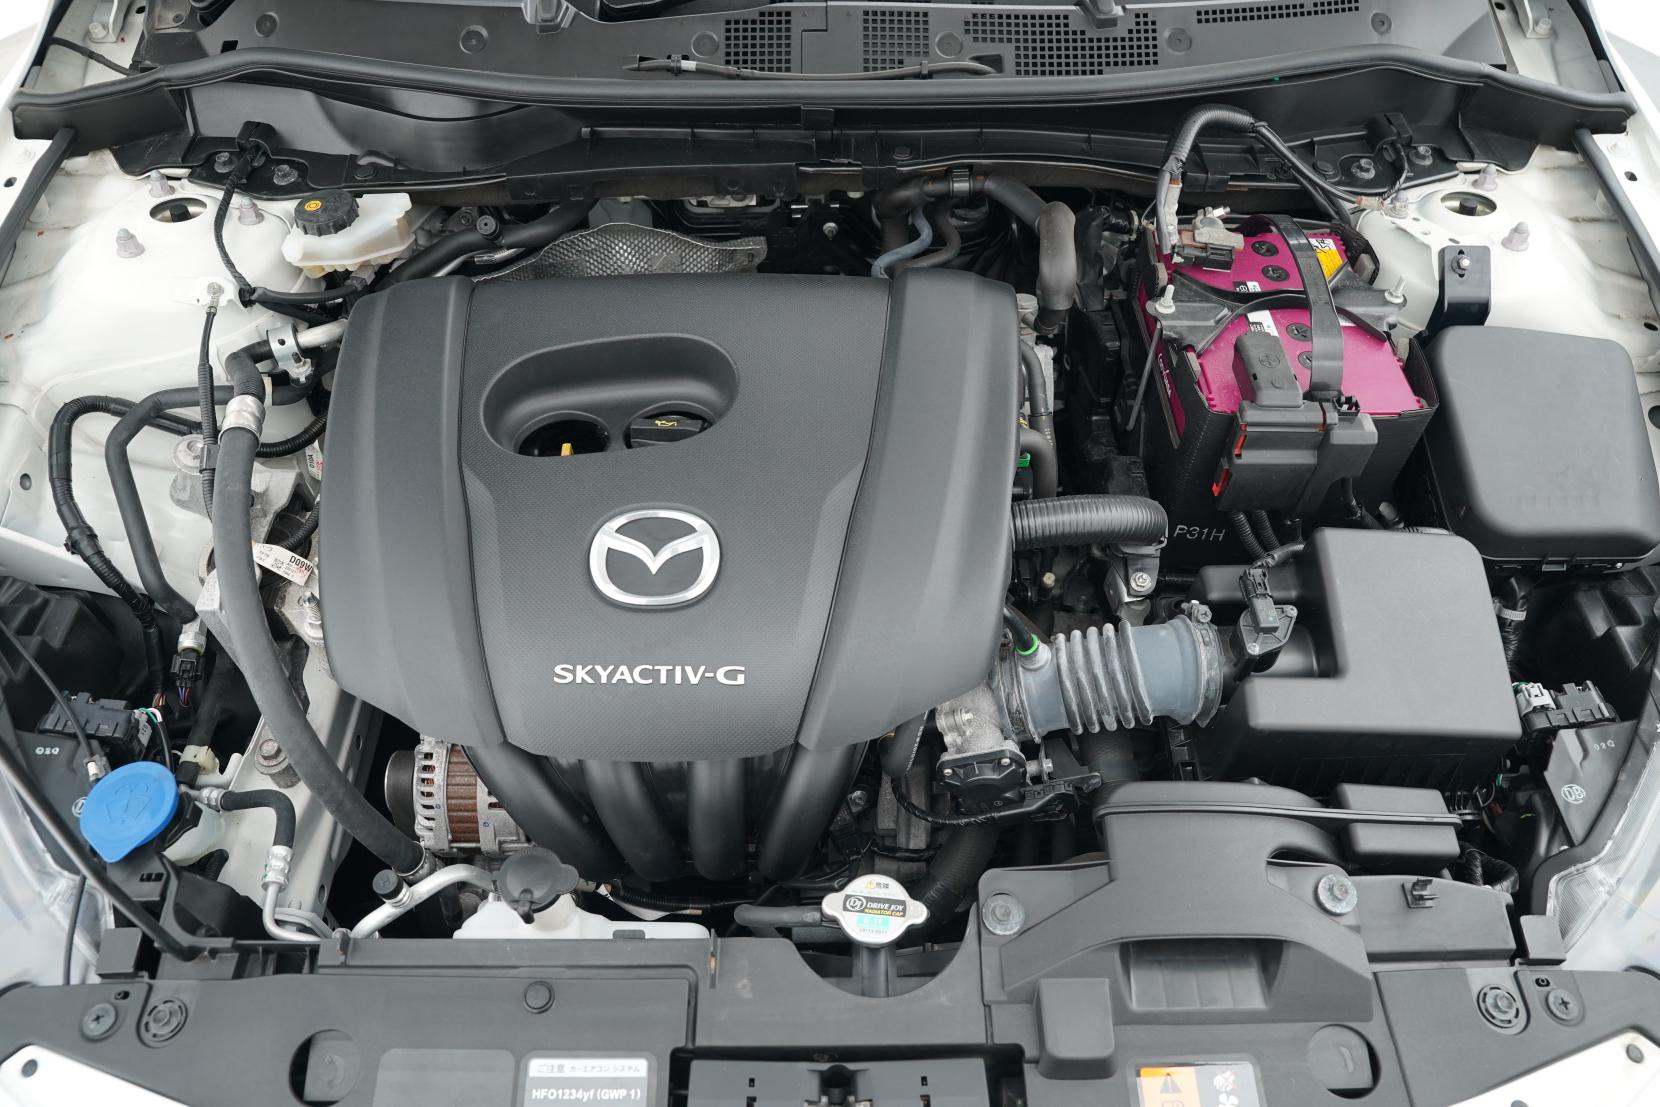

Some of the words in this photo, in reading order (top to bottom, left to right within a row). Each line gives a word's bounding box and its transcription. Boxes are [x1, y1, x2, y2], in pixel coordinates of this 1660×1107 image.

[1173, 525, 1226, 541] P31H
[289, 555, 313, 573] D09W
[553, 664, 746, 686] SKYACTIV-G
[532, 1088, 595, 1102] HFO1234yf
[597, 1088, 627, 1101] (GWP
[629, 1088, 641, 1101] 1)
